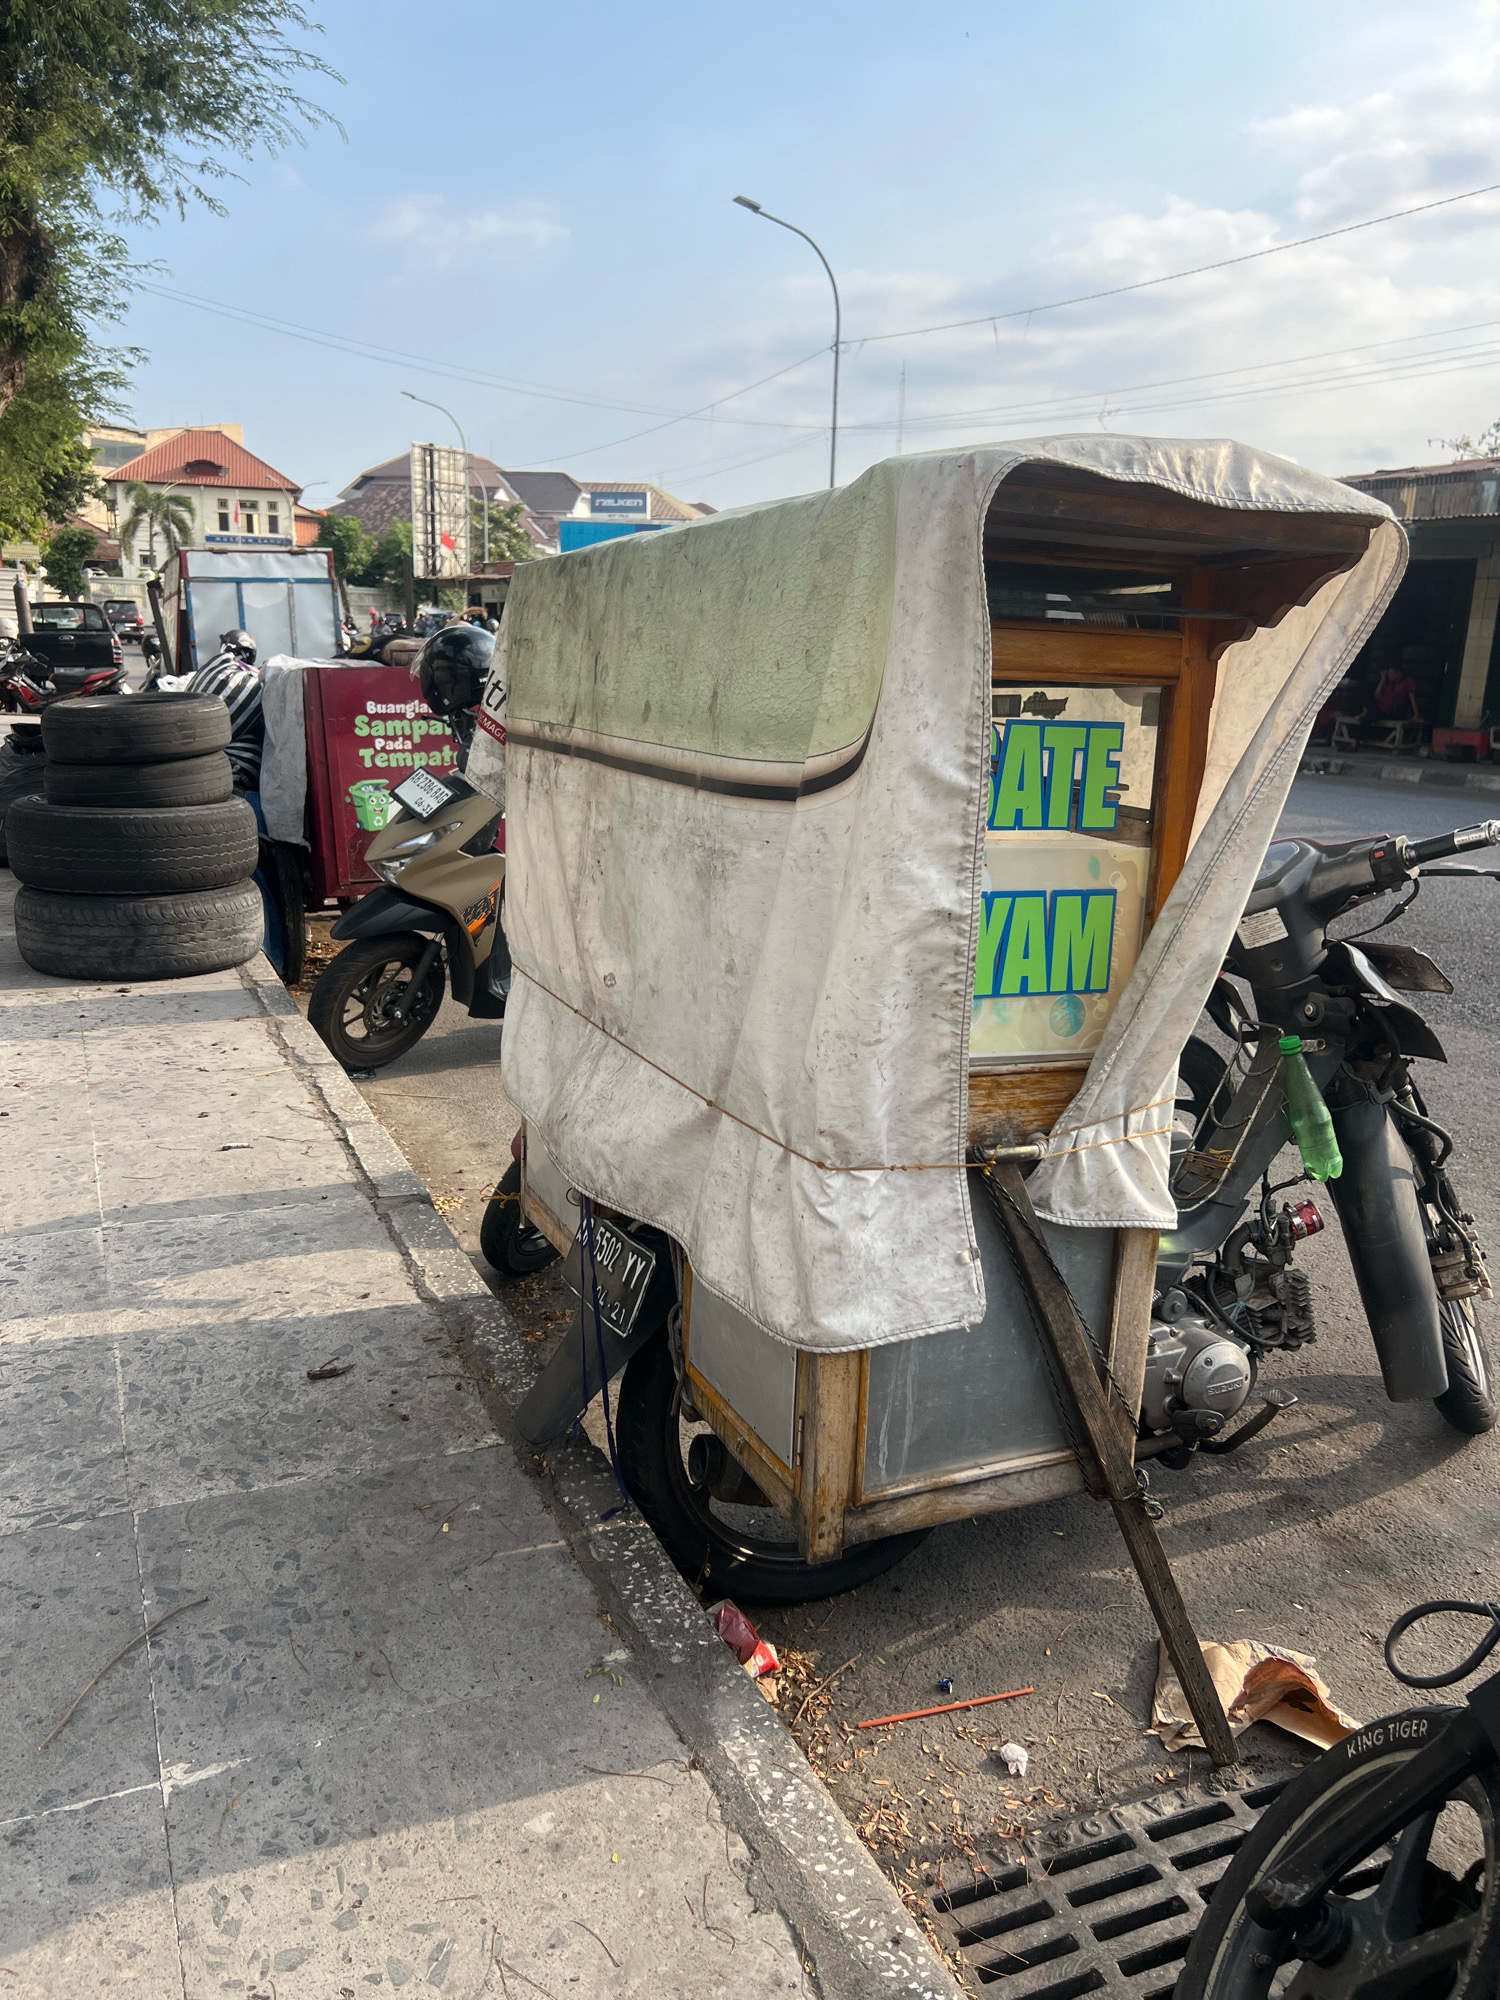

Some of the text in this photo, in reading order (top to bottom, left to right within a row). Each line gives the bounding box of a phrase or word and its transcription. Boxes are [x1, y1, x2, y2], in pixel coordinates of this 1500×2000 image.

[594, 498, 643, 507] FALKEN
[366, 700, 433, 719] Buangla
[375, 737, 412, 750] Pada
[974, 889, 1117, 999] YAM
[594, 1226, 622, 1273] 5502
[622, 1251, 646, 1289] YY
[1207, 1379, 1243, 1396] SUZUKI
[1346, 1719, 1428, 1758] KING TIGER
